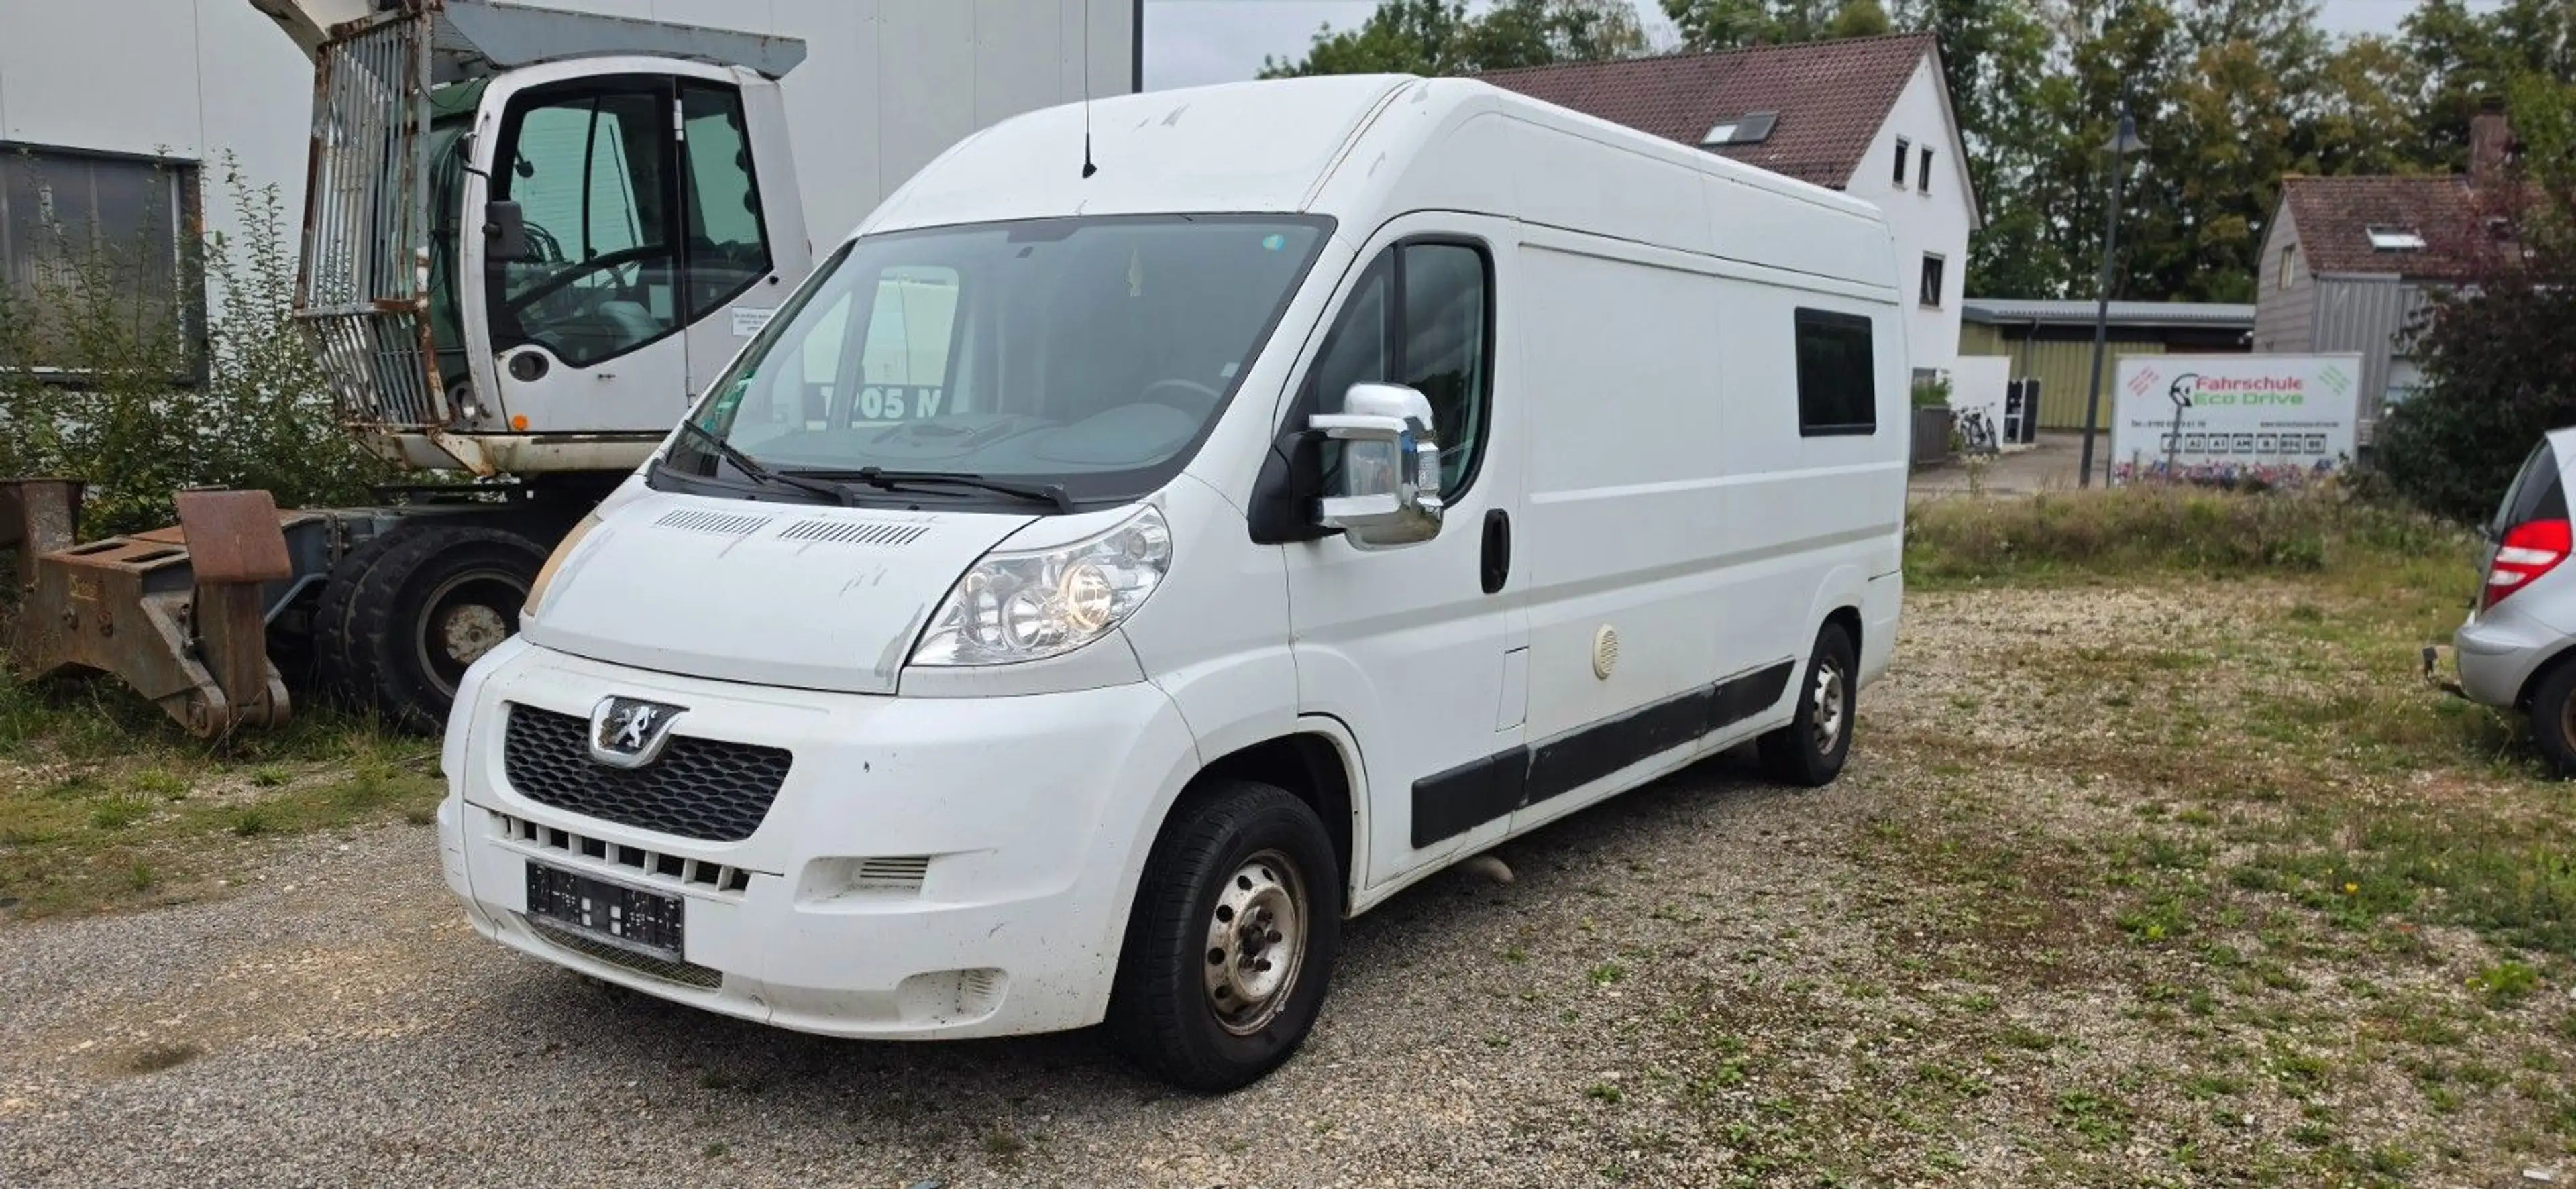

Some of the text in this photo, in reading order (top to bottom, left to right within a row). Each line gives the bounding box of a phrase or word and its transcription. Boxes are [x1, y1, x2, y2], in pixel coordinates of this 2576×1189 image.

[2196, 376, 2304, 390] Fahrschule
[2194, 392, 2304, 406] Eco Drive
